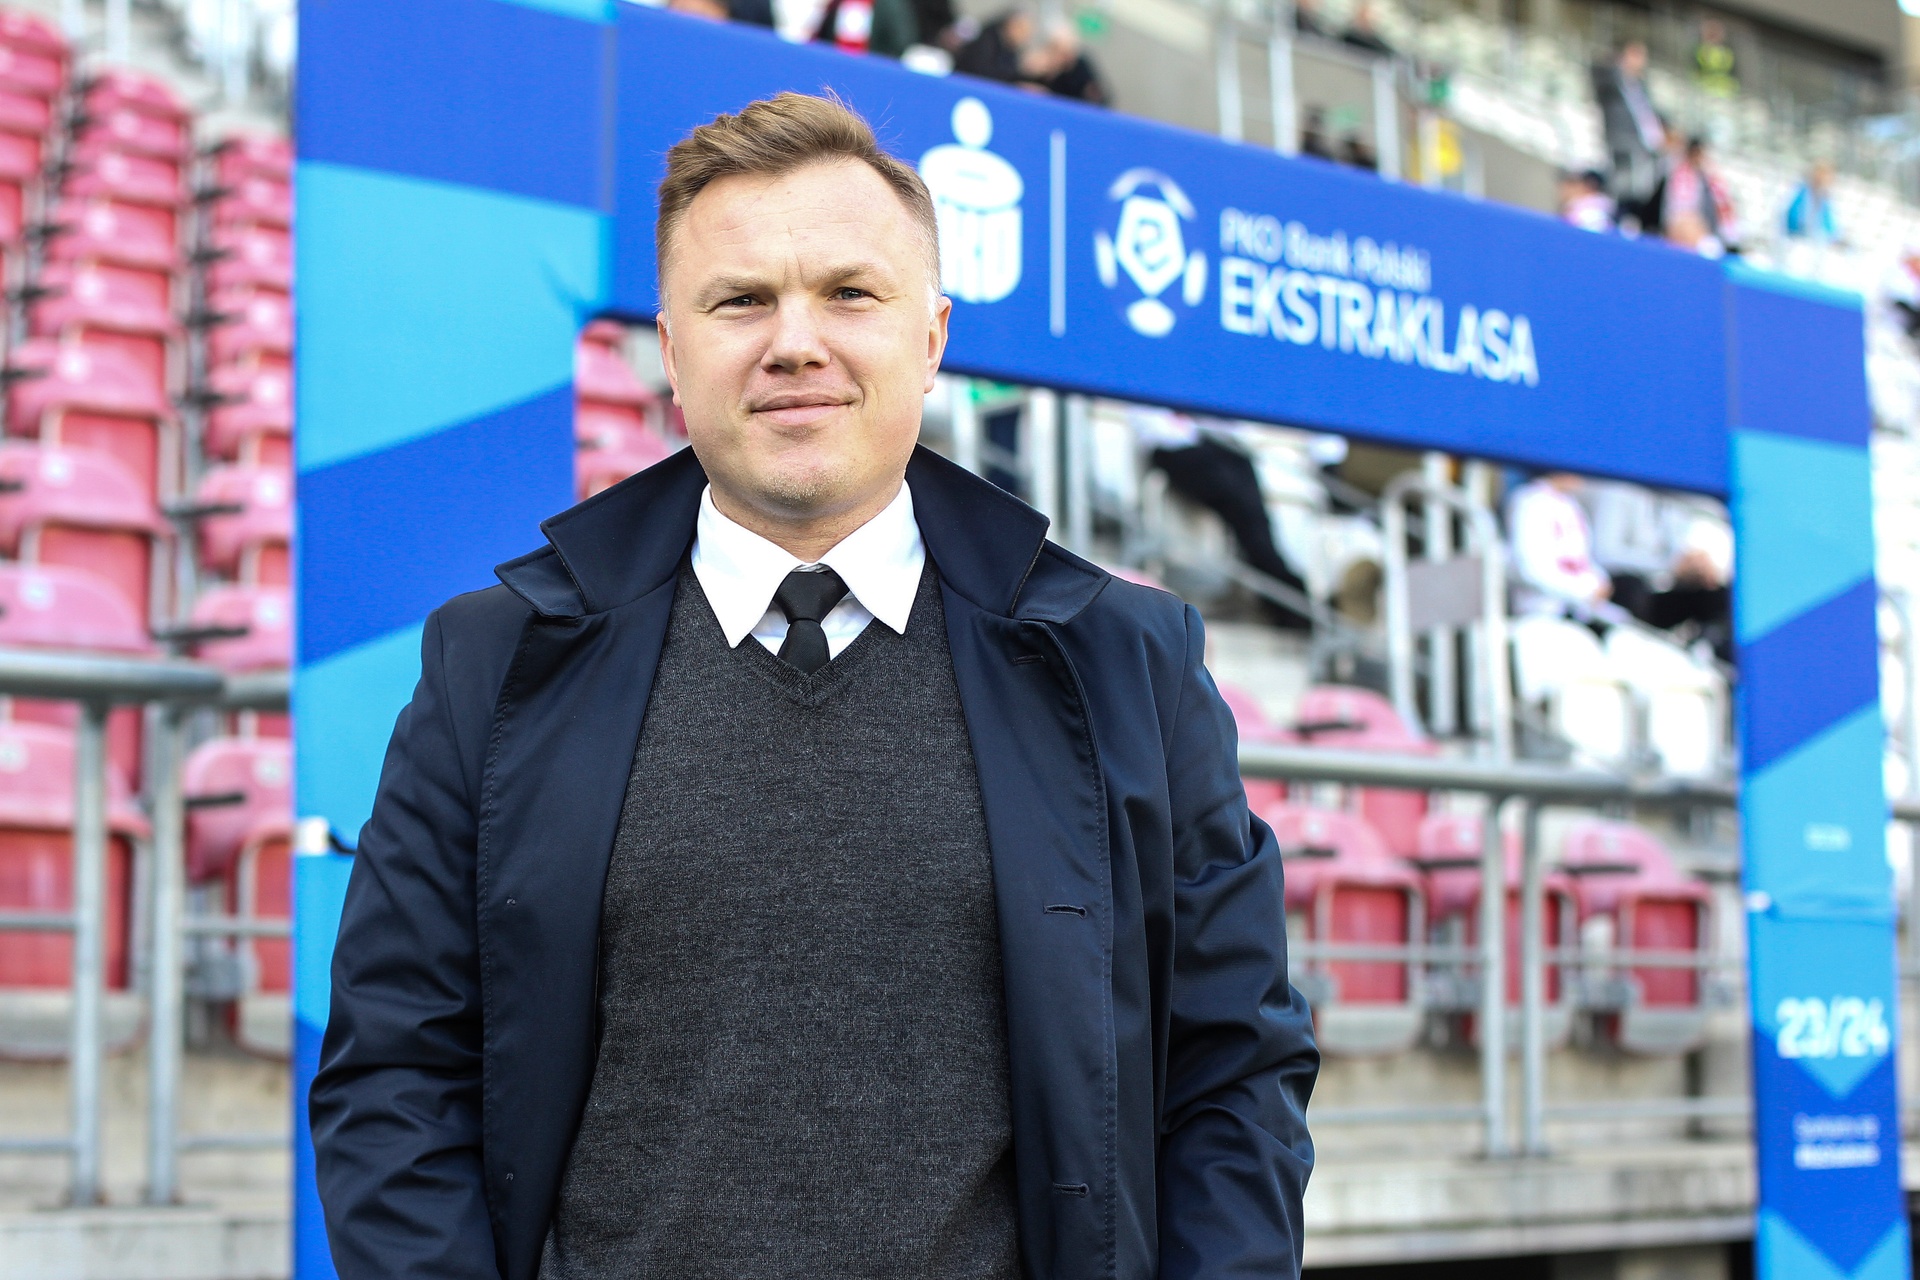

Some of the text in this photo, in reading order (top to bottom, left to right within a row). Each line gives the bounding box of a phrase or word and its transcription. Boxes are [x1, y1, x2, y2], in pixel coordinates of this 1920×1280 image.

[1221, 207, 1283, 262] PKO
[1285, 221, 1351, 276] Bank
[1220, 256, 1540, 388] EKSTRAKLASA
[1776, 995, 1890, 1058] 23/24
